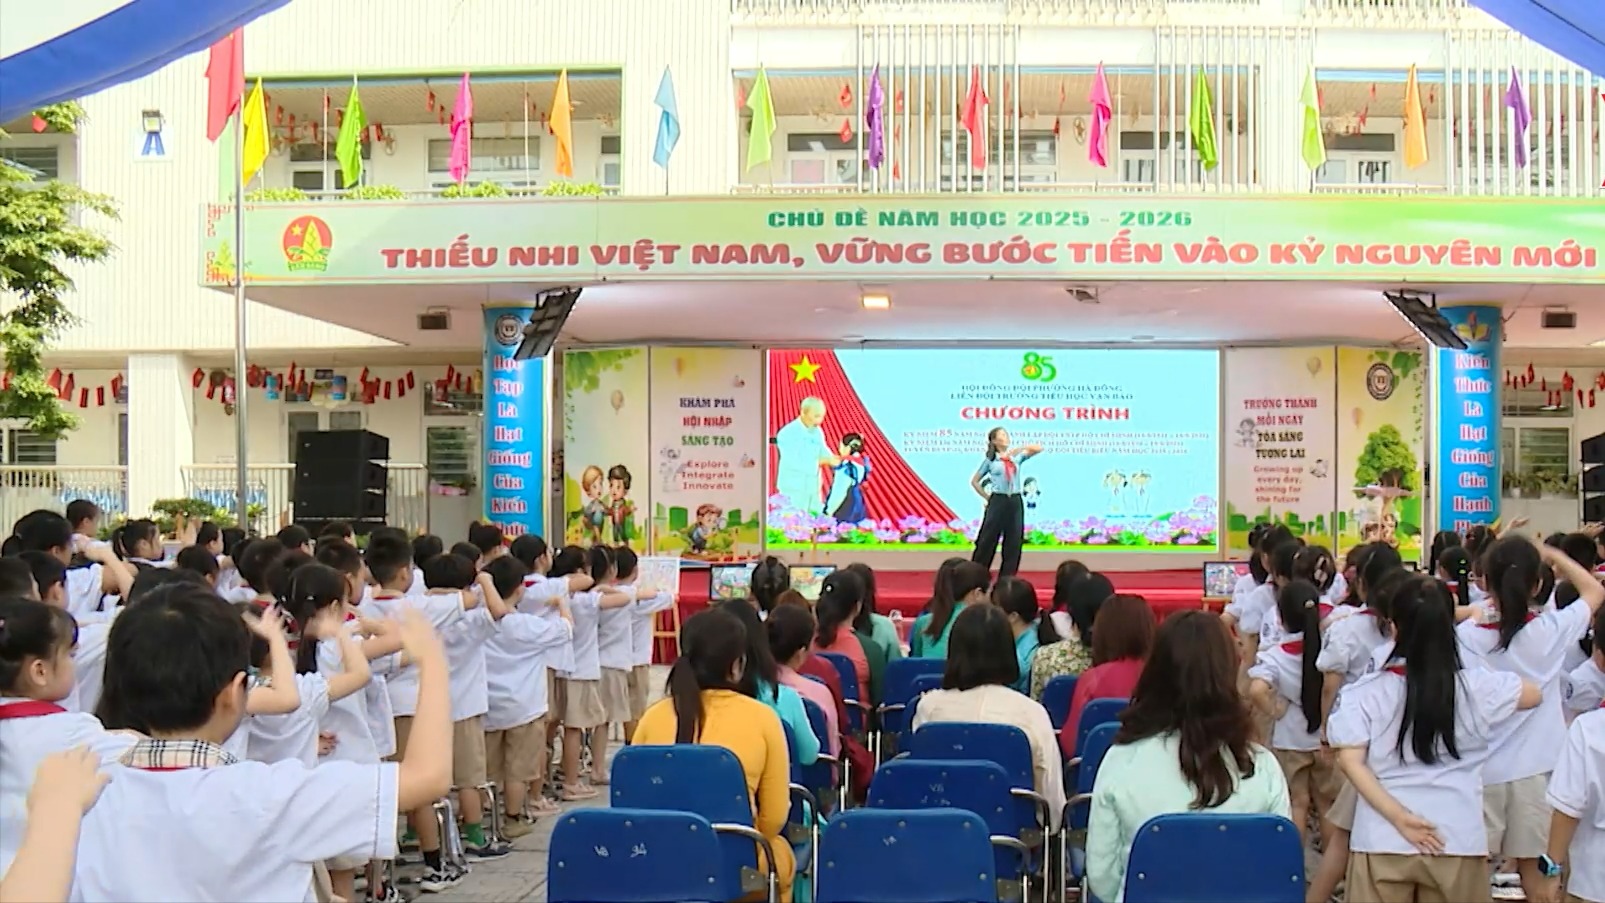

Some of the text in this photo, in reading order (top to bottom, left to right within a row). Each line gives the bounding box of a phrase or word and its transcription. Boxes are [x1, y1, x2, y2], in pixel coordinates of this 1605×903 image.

[768, 208, 824, 227] CHỦ
[835, 208, 868, 227] ĐỀ
[879, 210, 939, 227] NĂM
[950, 211, 1006, 229] HỌC
[1018, 211, 1090, 227] 2025
[1119, 211, 1192, 227] 2026
[381, 230, 1596, 270] THIẾU NHI VIỆT NAM, VỮNG BƯỚC TIẾN VÀO KỶ NGUYÊN MỚI
[1021, 351, 1057, 382] 85
[961, 403, 1130, 420] CHƯƠNG TRÌNH
[687, 460, 730, 469] Explore
[681, 471, 735, 480] Integrate
[682, 481, 734, 490] Innovate
